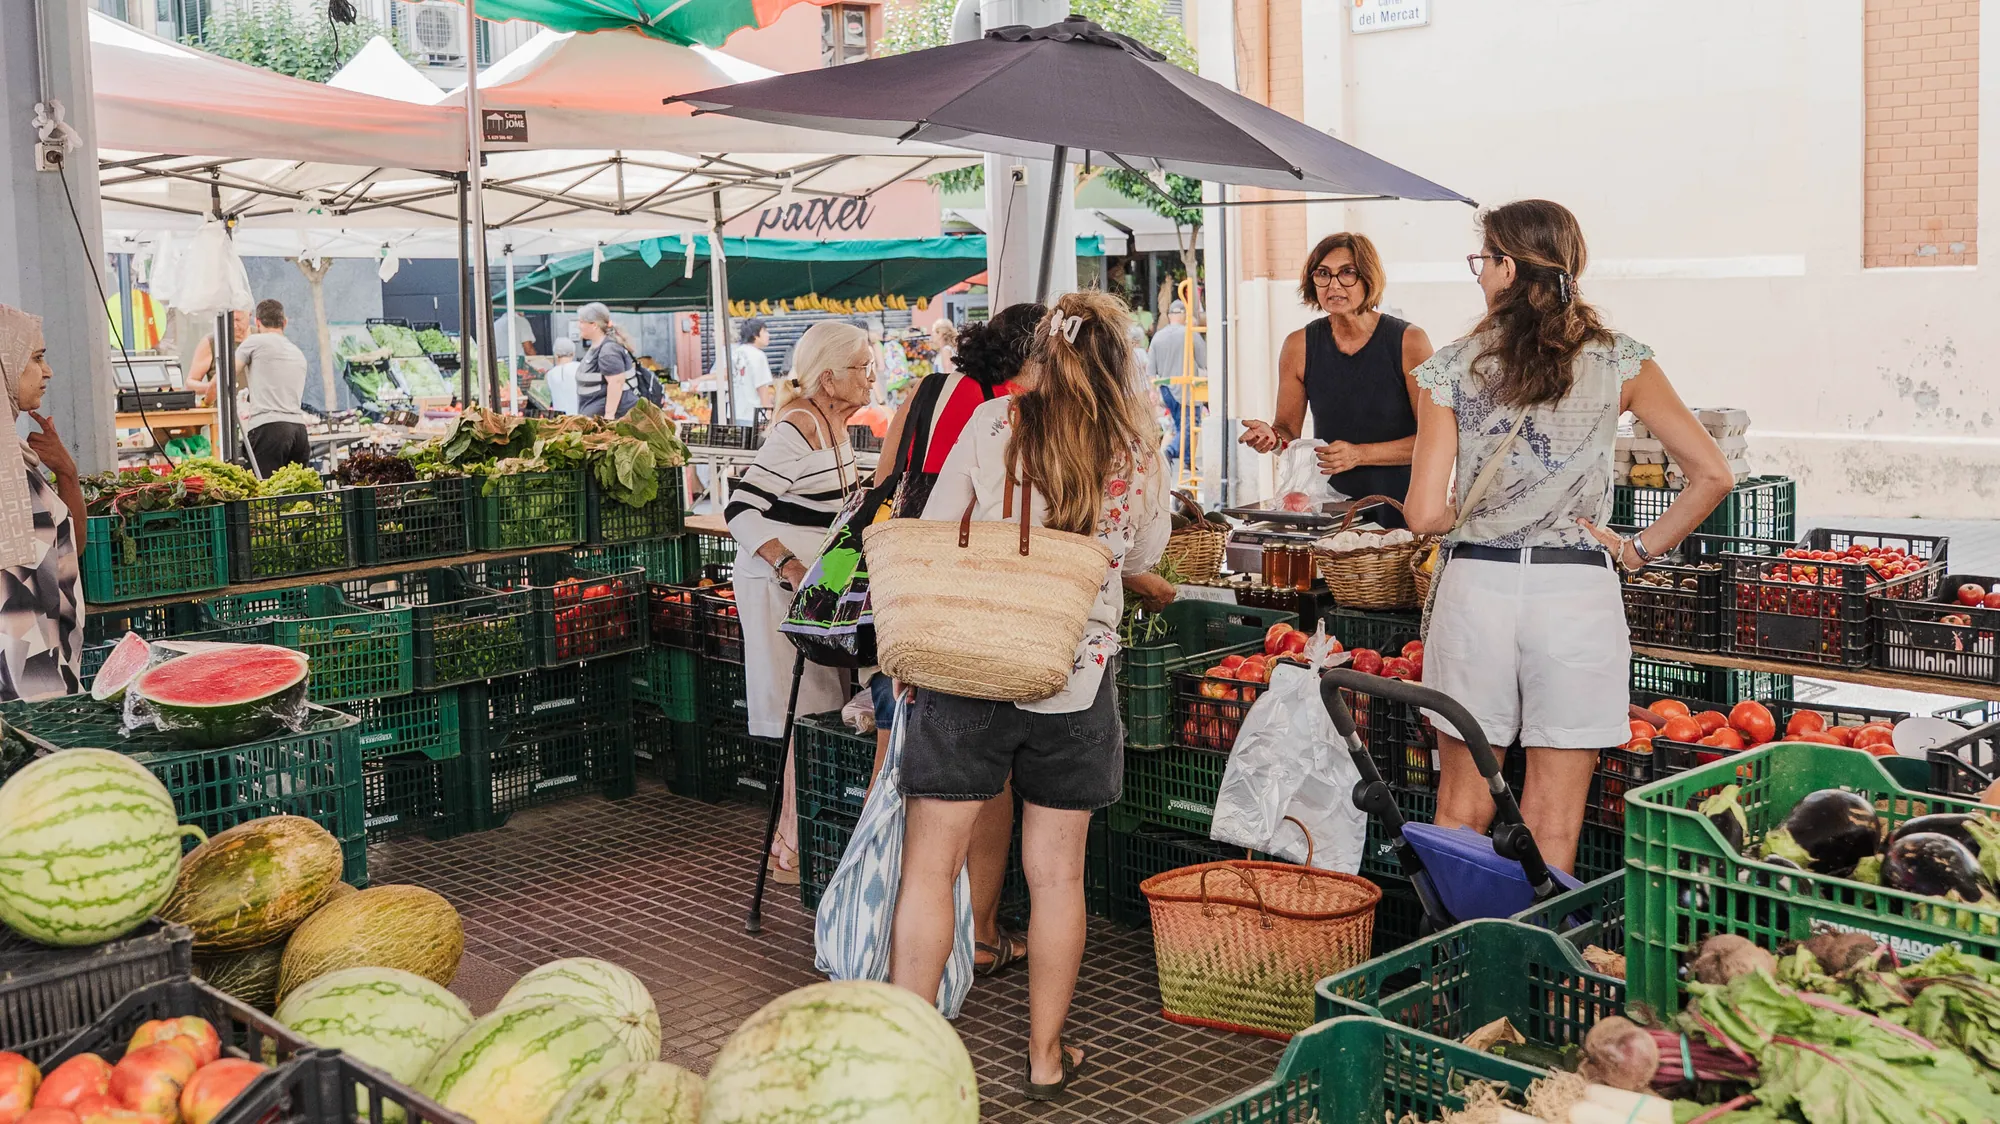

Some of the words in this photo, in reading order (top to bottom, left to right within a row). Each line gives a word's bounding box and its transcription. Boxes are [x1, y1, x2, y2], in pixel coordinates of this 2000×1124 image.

[1359, 12, 1375, 25] del
[1380, 8, 1419, 23] Mercat
[504, 112, 523, 120] Carpas
[505, 120, 525, 129] JOME
[1190, 803, 1214, 815] ERDURES
